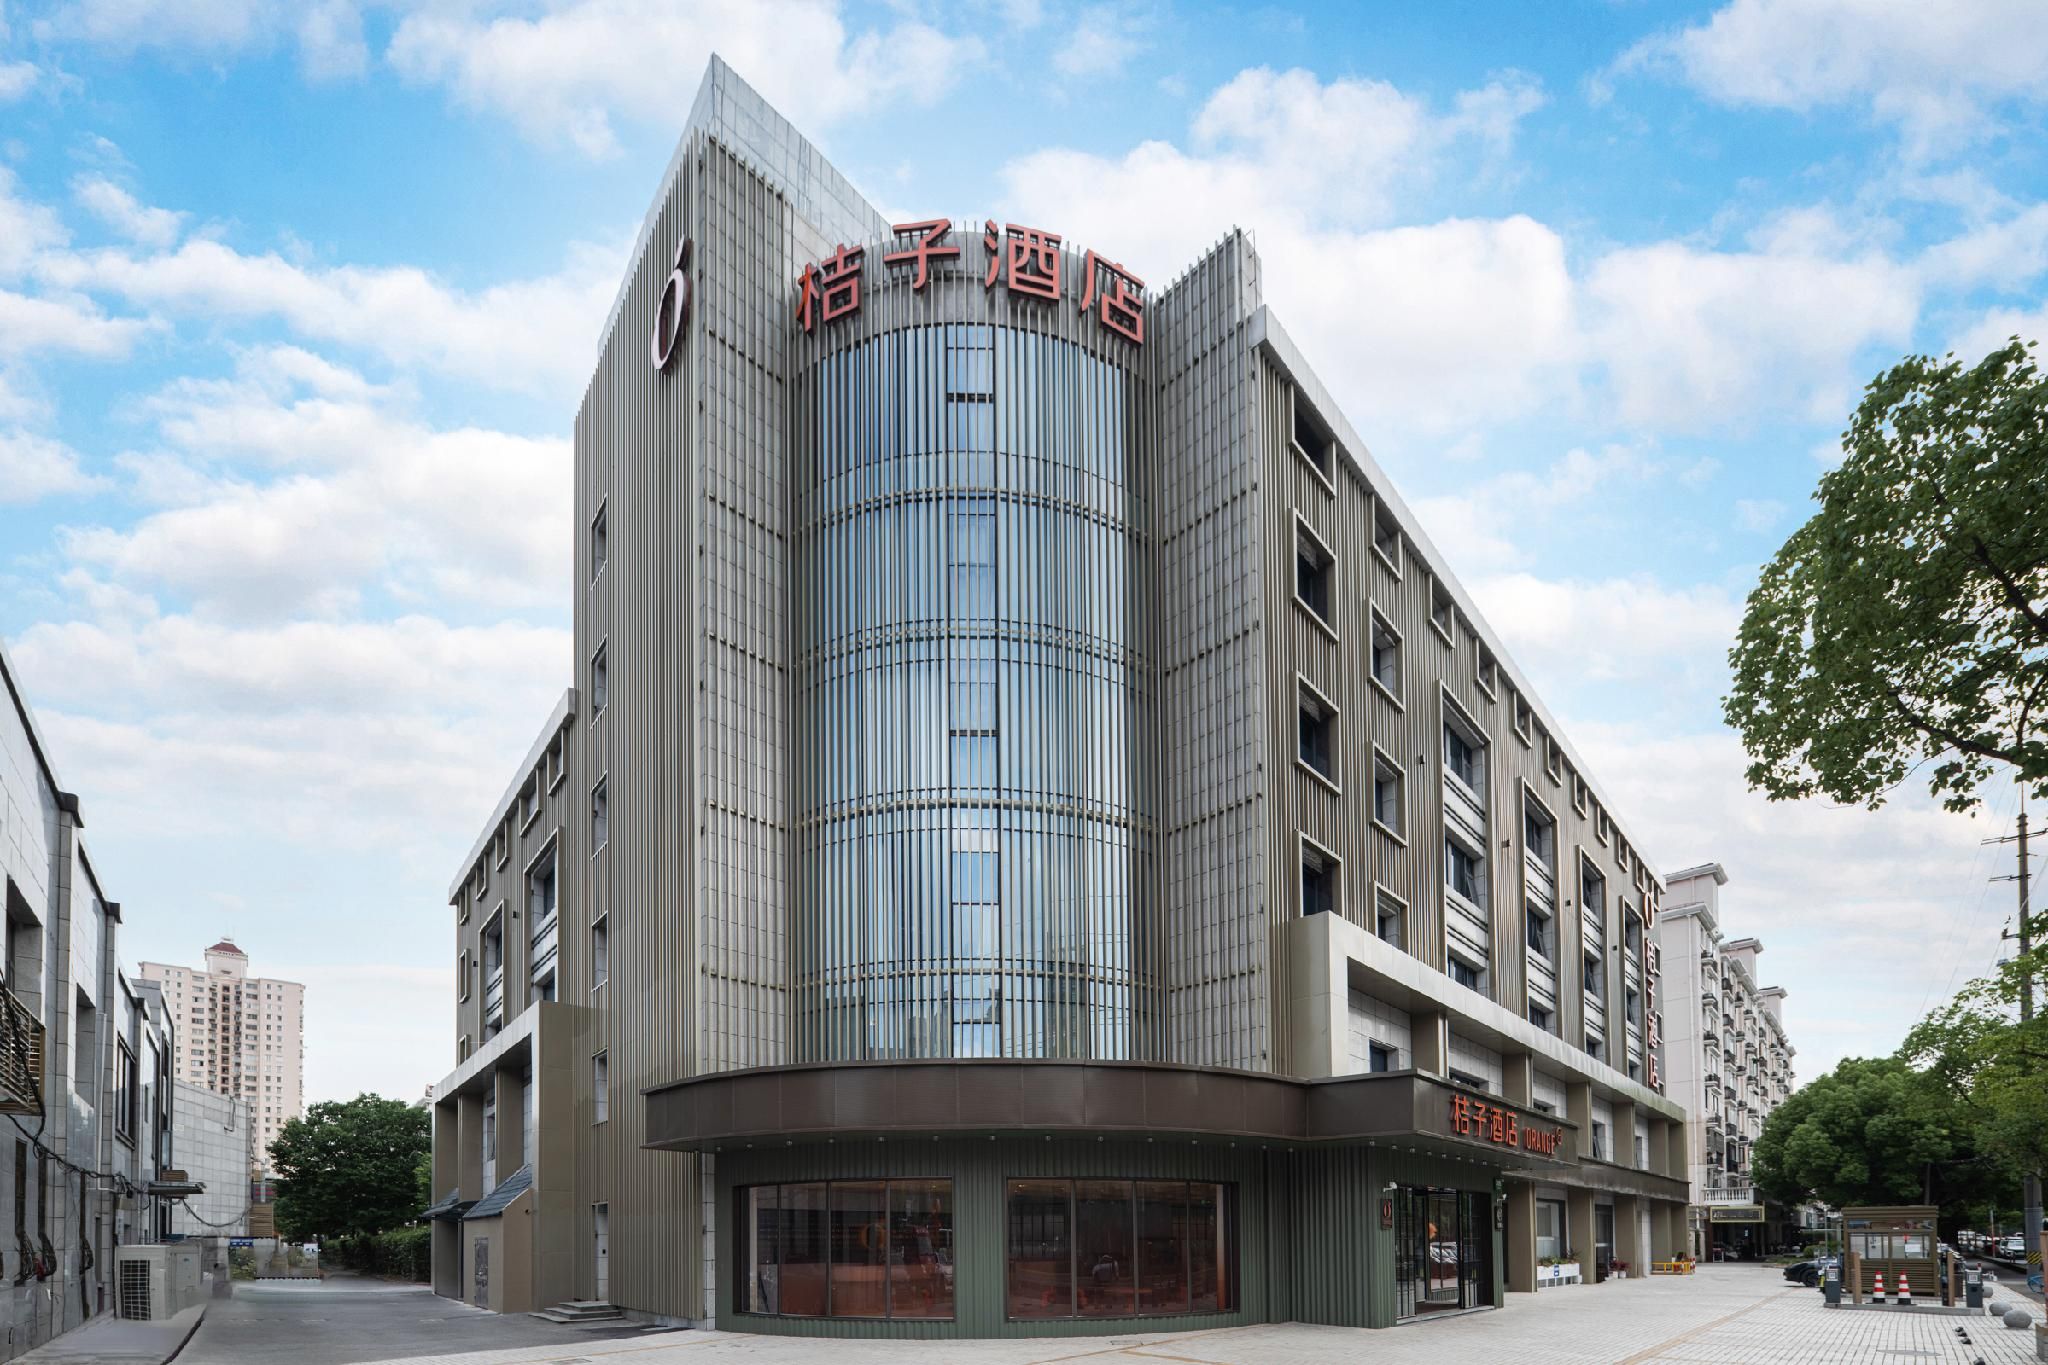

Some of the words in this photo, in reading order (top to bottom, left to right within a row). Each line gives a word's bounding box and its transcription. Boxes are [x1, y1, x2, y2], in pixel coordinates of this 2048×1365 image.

[796, 218, 1145, 345] 桔子酒店
[1453, 1094, 1518, 1147] 桔子酒店
[1525, 1127, 1556, 1155] ORANGE
